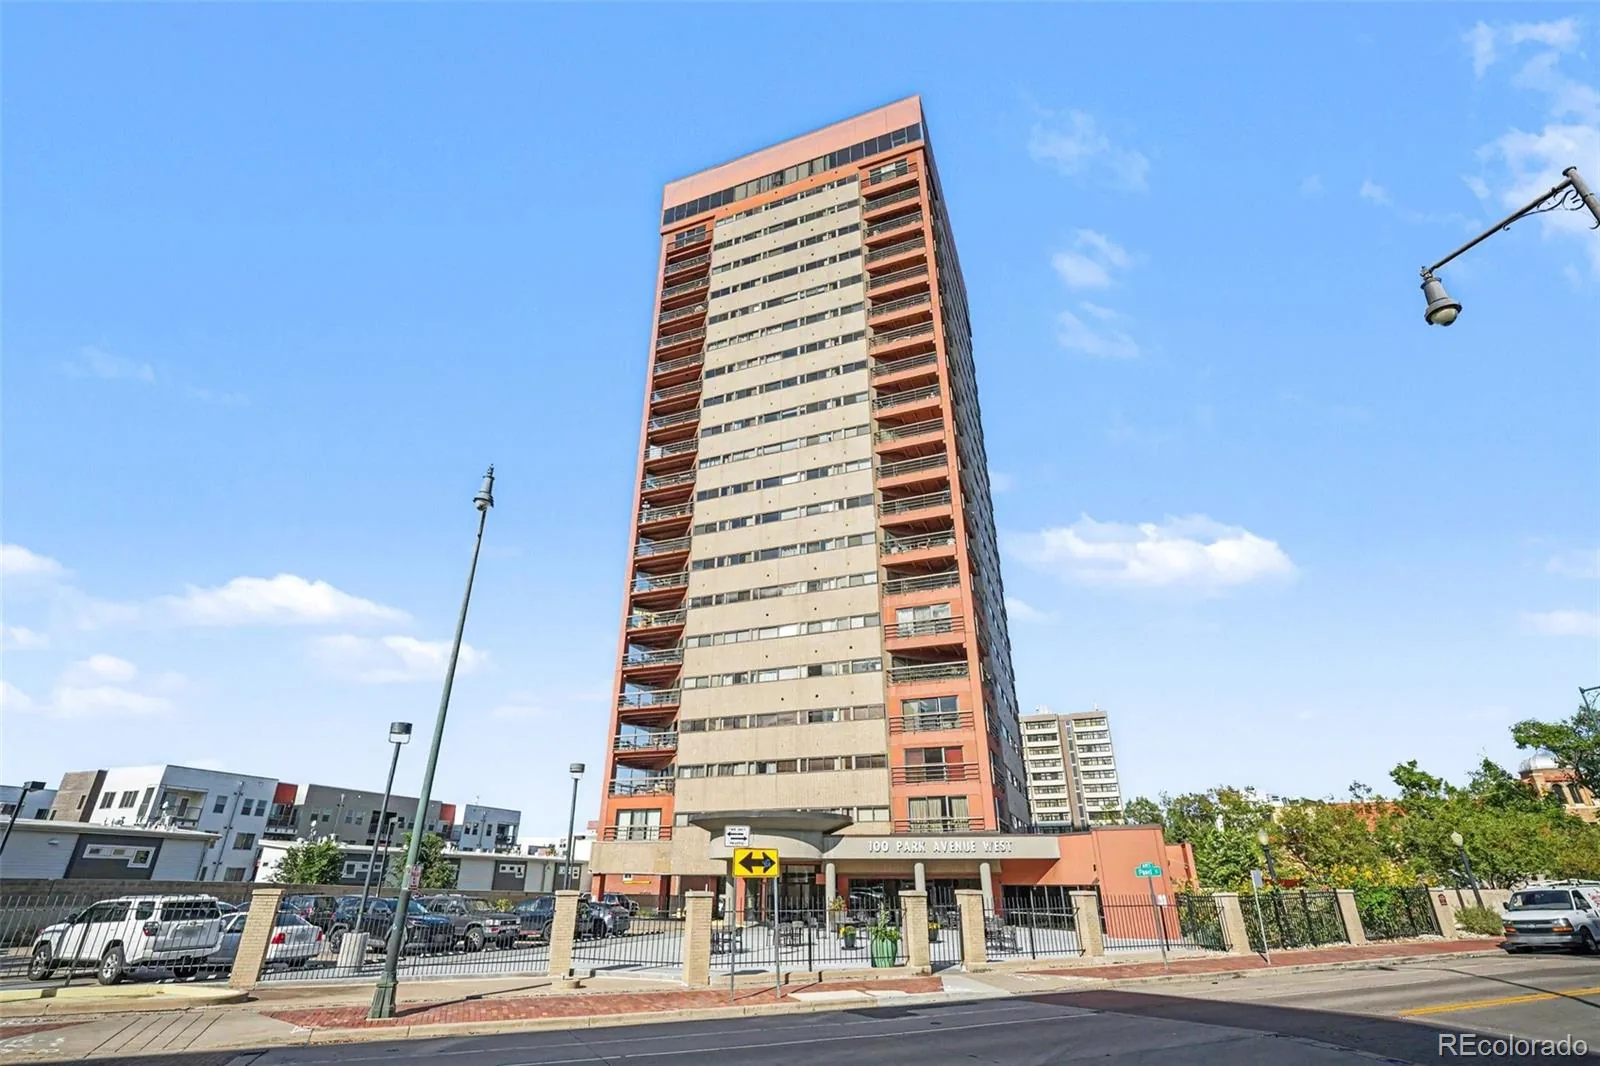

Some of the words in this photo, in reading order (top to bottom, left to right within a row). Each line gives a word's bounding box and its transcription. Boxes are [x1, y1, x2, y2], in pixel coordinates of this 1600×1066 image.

[869, 840, 889, 853] 100
[896, 840, 926, 853] PARK
[933, 840, 977, 853] AVENUE
[982, 840, 1013, 853] WEST
